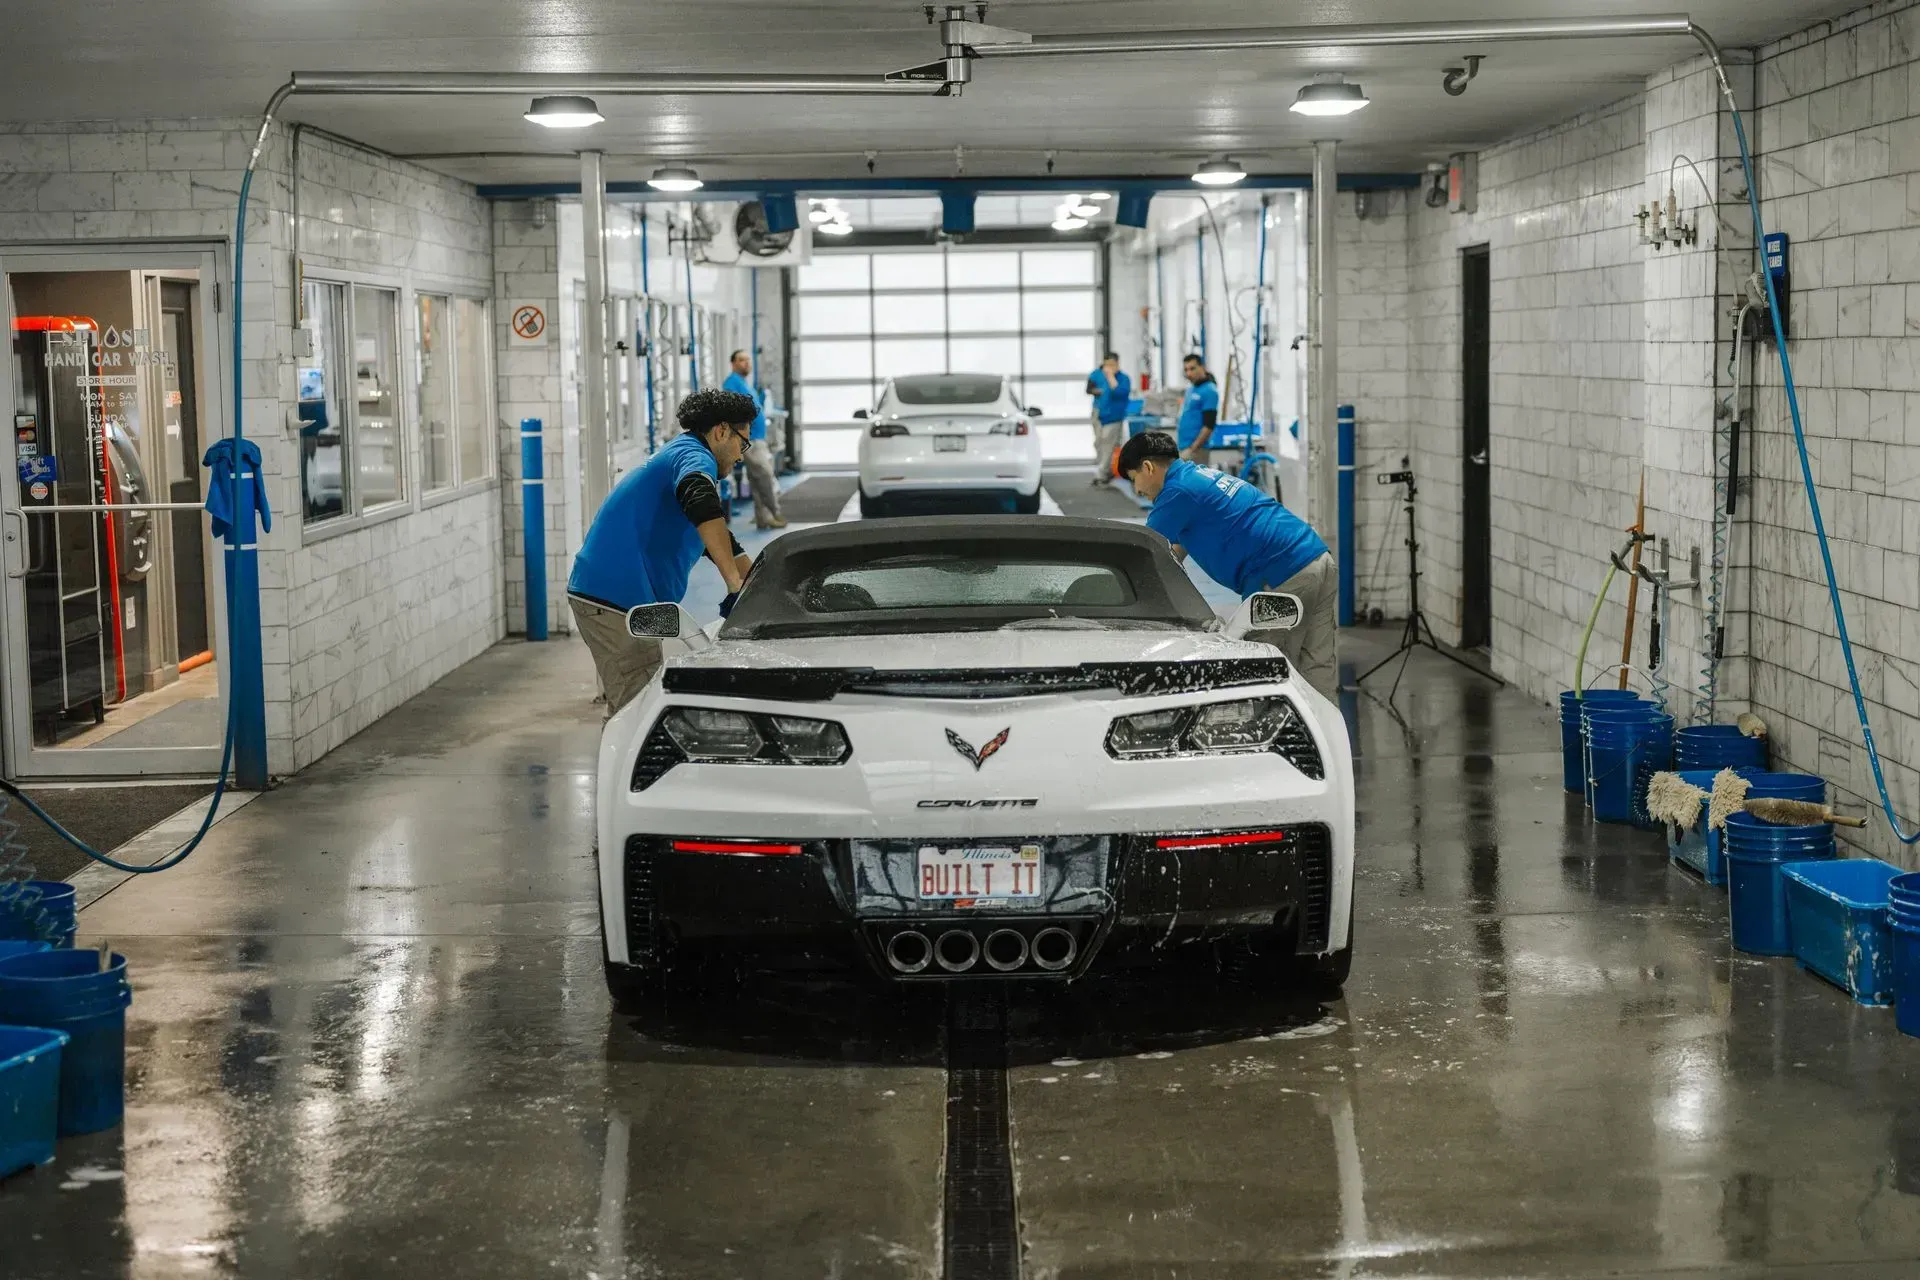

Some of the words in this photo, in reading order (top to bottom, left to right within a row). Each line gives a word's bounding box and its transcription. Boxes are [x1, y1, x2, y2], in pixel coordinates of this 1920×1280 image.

[44, 352, 86, 367] HAND
[92, 352, 121, 367] CAR
[128, 352, 169, 366] WASH
[80, 392, 106, 401] MON
[90, 414, 129, 422] SUNDA
[917, 798, 1039, 808] CORVETTE
[961, 847, 1011, 859] Illinois
[921, 863, 995, 895] BUILT
[1011, 862, 1037, 895] IT
